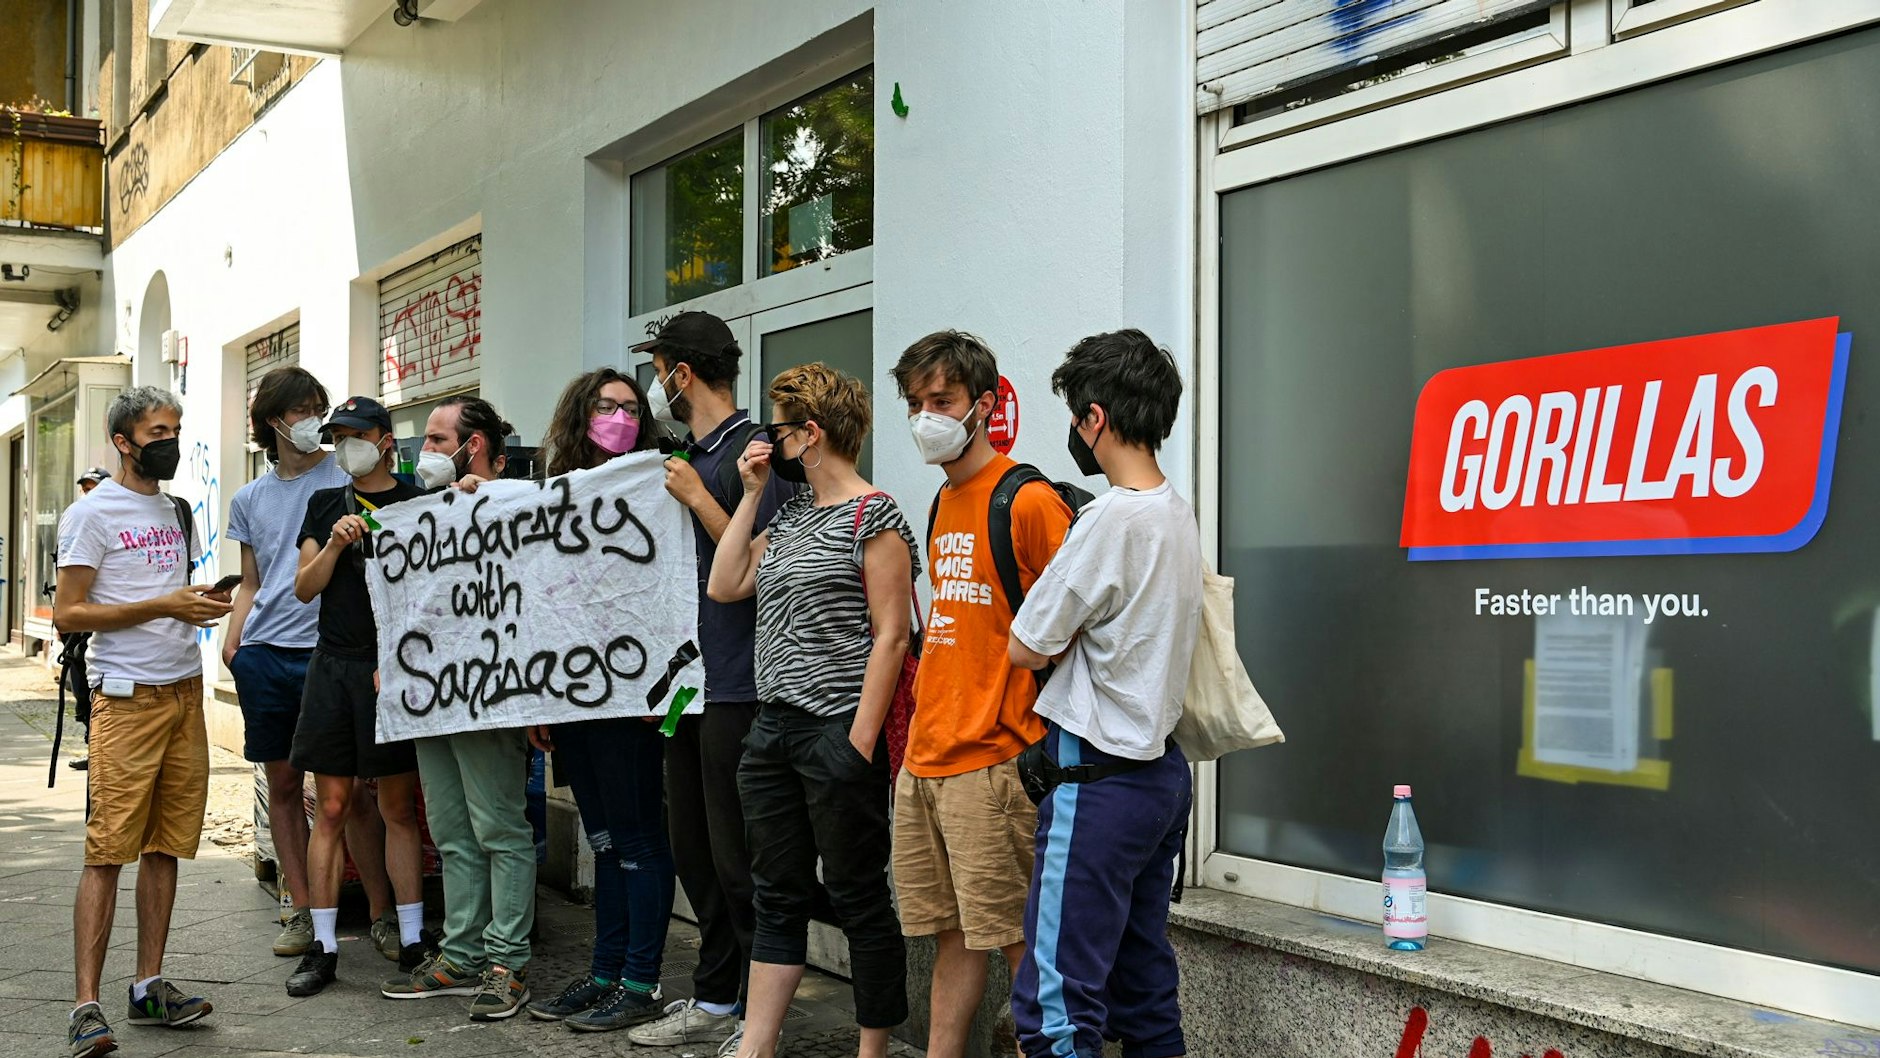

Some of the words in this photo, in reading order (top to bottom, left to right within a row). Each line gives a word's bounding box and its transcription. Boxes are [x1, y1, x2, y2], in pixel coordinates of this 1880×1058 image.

[1439, 366, 1778, 513] GORILLAS
[452, 560, 522, 619] with
[1474, 588, 1561, 616] Faster
[1569, 585, 1634, 616] than
[1643, 593, 1708, 625] you.
[397, 624, 647, 719] Santiago
